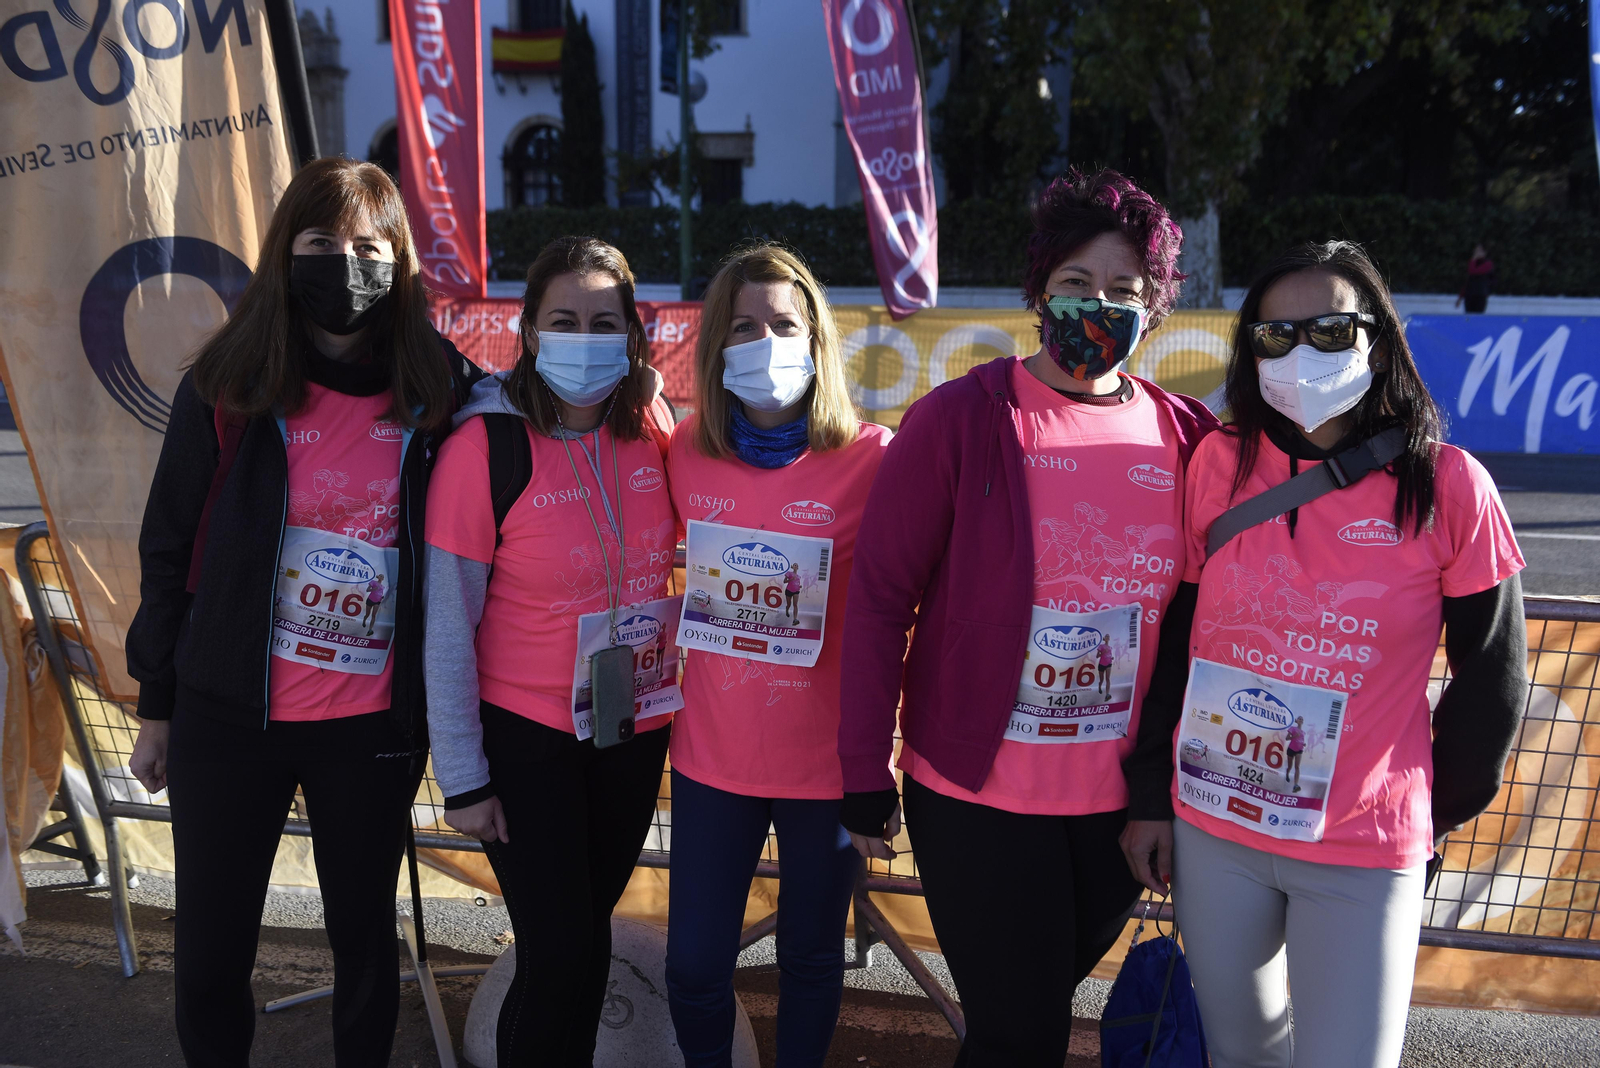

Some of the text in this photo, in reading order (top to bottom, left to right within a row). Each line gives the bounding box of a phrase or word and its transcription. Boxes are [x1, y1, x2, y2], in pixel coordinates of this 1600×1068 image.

[1458, 325, 1599, 453] Ma
[1024, 455, 1077, 472] YSHO
[1133, 470, 1175, 486] ASTURIANA
[533, 486, 591, 508] OYSHO
[689, 493, 735, 511] OYSHO
[786, 508, 831, 521] ASTURIANA
[1342, 529, 1398, 541] ASTURIANA
[310, 554, 369, 579] ASTURIANA
[727, 551, 784, 571] ASTURIANA
[1132, 553, 1175, 576] POR
[725, 580, 783, 609] 016
[1100, 576, 1166, 600] TODAS
[300, 583, 364, 617] 016
[306, 614, 341, 631] 2719
[737, 609, 766, 622] 2717
[1320, 611, 1379, 637] POR
[273, 617, 370, 647] CARRERA DE LA MUJER
[614, 626, 657, 642] ASTURIANA
[709, 616, 798, 637] CARRERA DE LA MUJER
[684, 628, 727, 646] OYSHO
[742, 641, 763, 650] Santander
[1039, 633, 1097, 651] ASTURIANA
[307, 647, 331, 658] Santander
[785, 648, 813, 656] ZURICH
[1284, 630, 1372, 664] TODAS
[353, 656, 379, 665] ZURICH
[1232, 643, 1364, 690] NOSOTRAS
[792, 680, 811, 688] 2021
[1034, 663, 1096, 689] 016
[643, 682, 662, 694] MUJER
[652, 695, 674, 706] ZURICH
[1047, 694, 1077, 707] 1420
[1054, 709, 1067, 717] DE
[1068, 708, 1079, 716] LA
[1081, 705, 1110, 715] MUJER
[1232, 696, 1287, 726] ASTURIANA
[1097, 722, 1122, 731] ZURICH
[1225, 729, 1284, 769] 016
[1237, 764, 1264, 785] 1424
[1183, 782, 1221, 806] OYSHO
[1201, 770, 1298, 807] CARRERA DE LA MUJER
[1238, 804, 1258, 816] Santander
[1282, 819, 1312, 829] ZURICH
